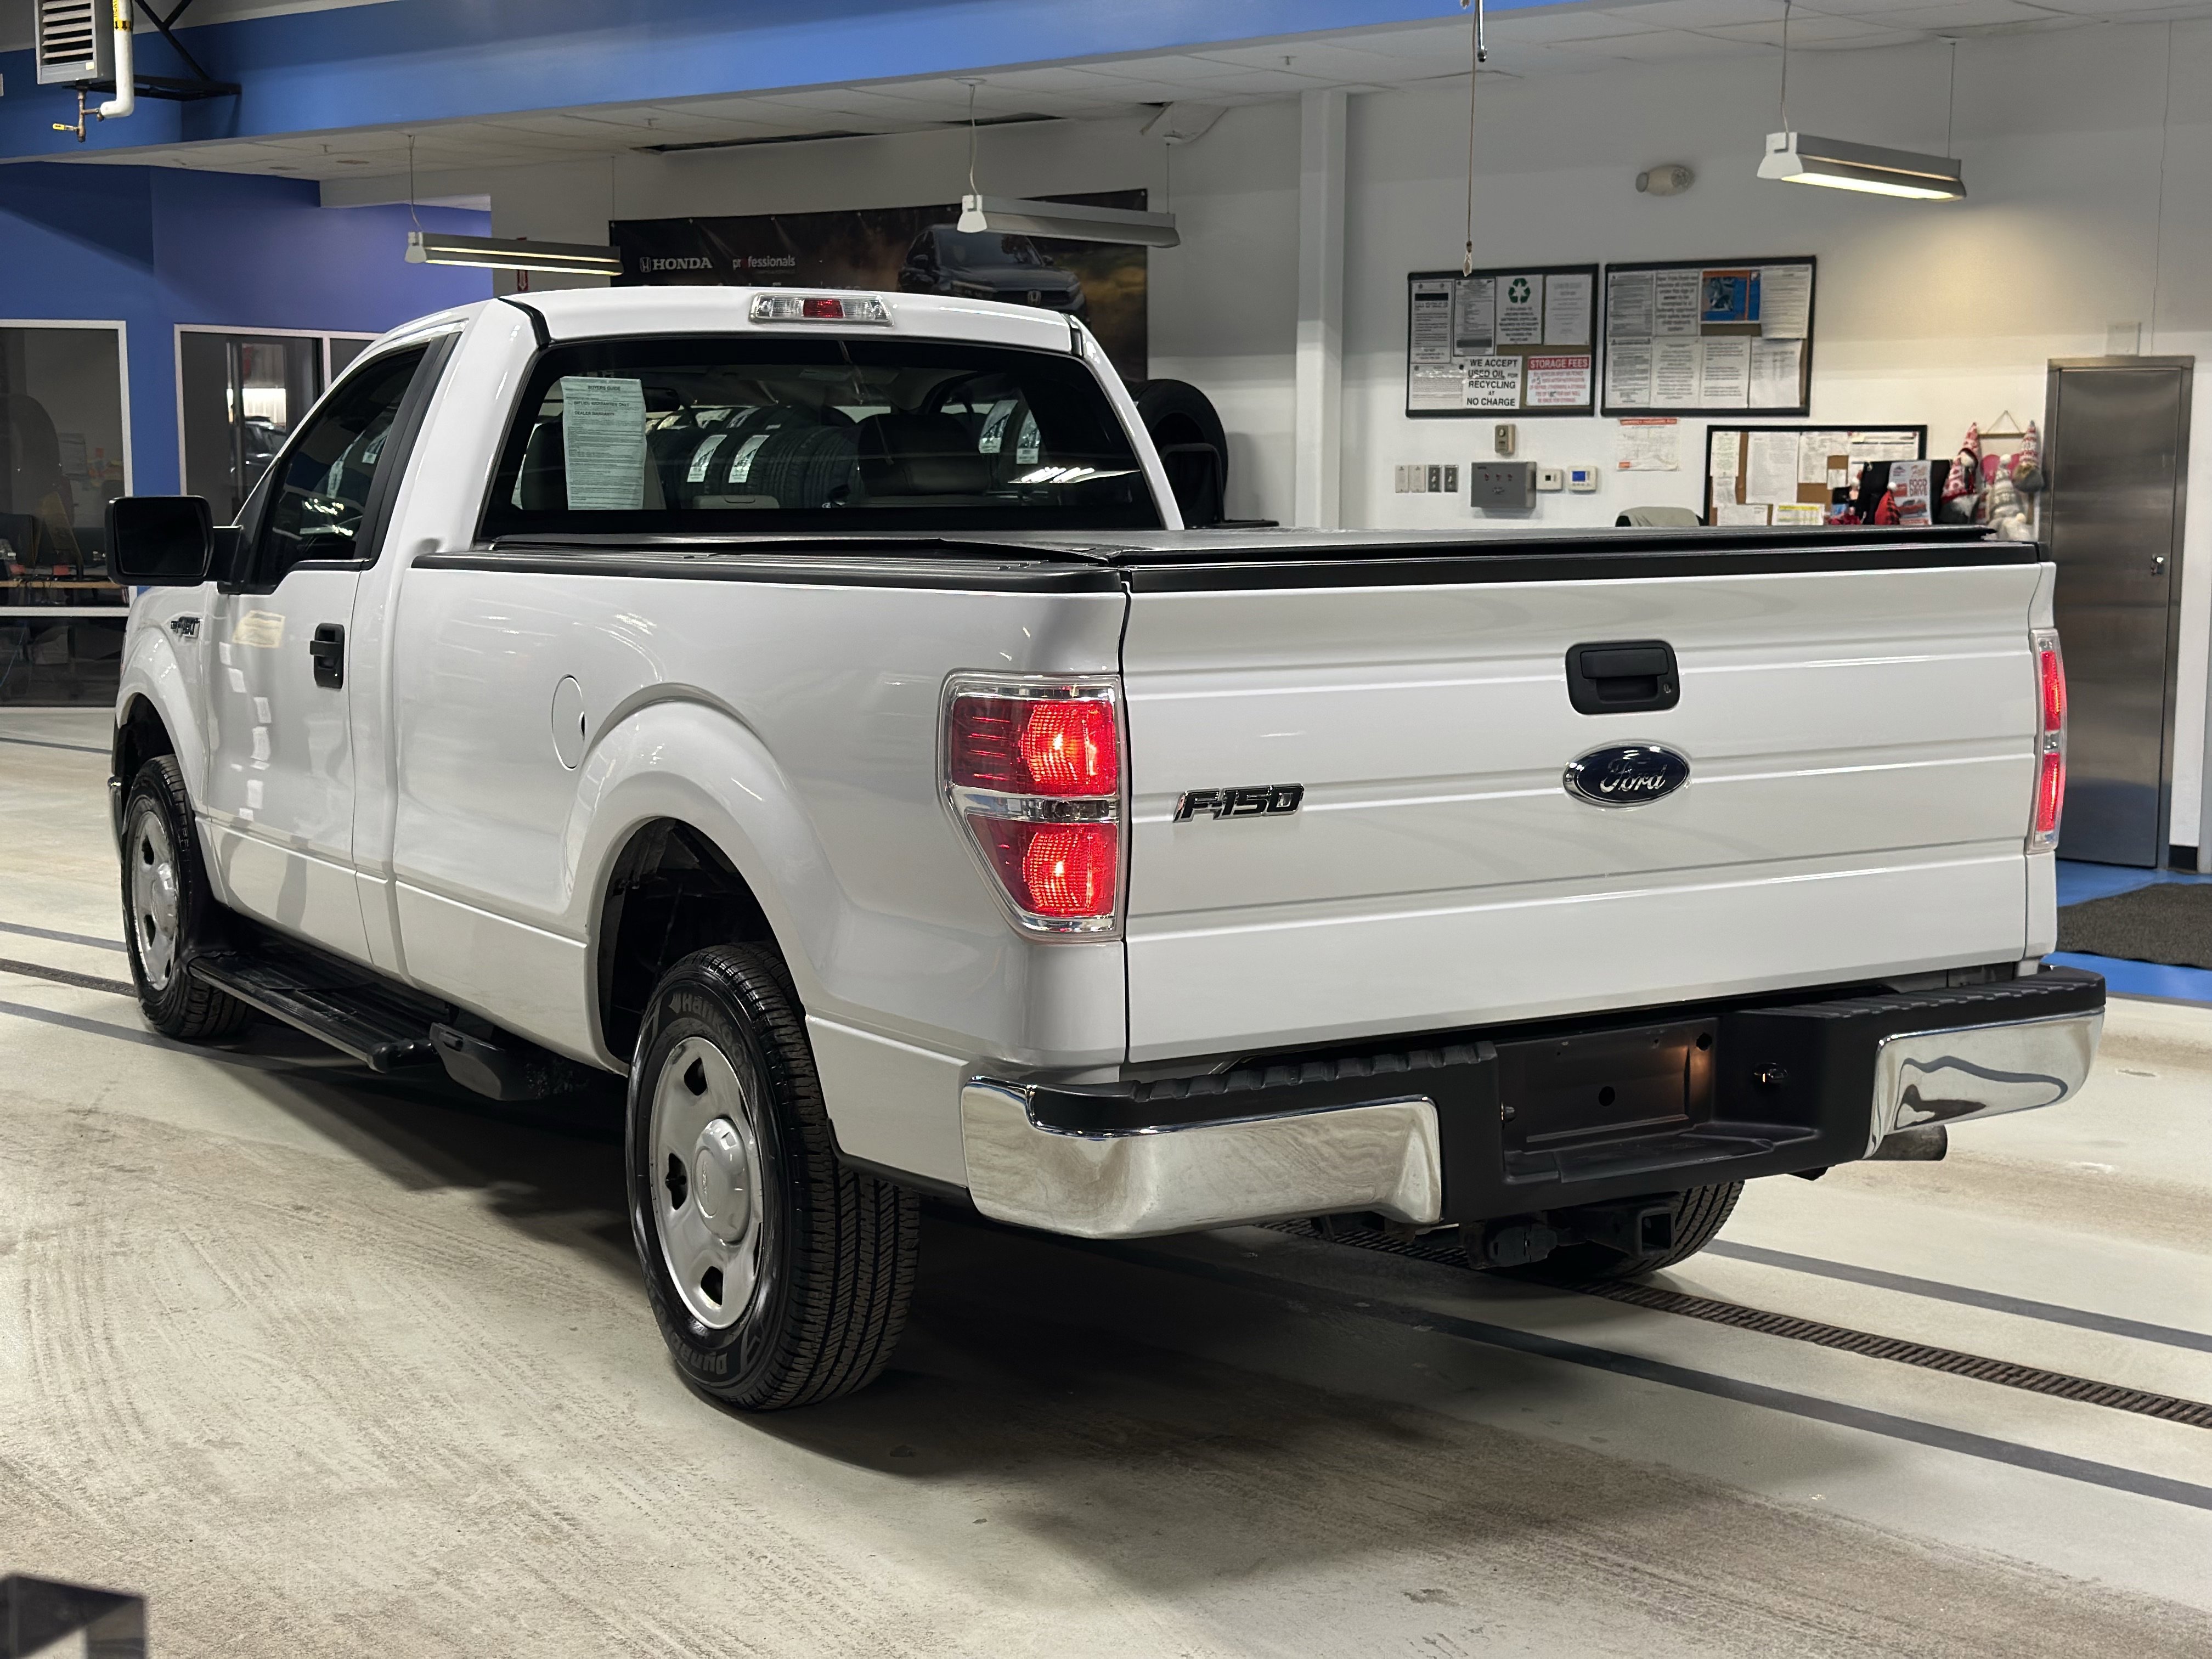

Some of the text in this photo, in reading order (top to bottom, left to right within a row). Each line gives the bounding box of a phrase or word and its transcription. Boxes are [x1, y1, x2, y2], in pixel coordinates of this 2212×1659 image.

[652, 257, 713, 270] HONDA
[732, 254, 796, 270] prfessionals
[1530, 358, 1588, 368] STORAGE FEES
[1468, 370, 1490, 378] USED
[1492, 370, 1505, 378] OIL
[1600, 758, 1668, 793] Ford
[1173, 783, 1305, 823] F-150
